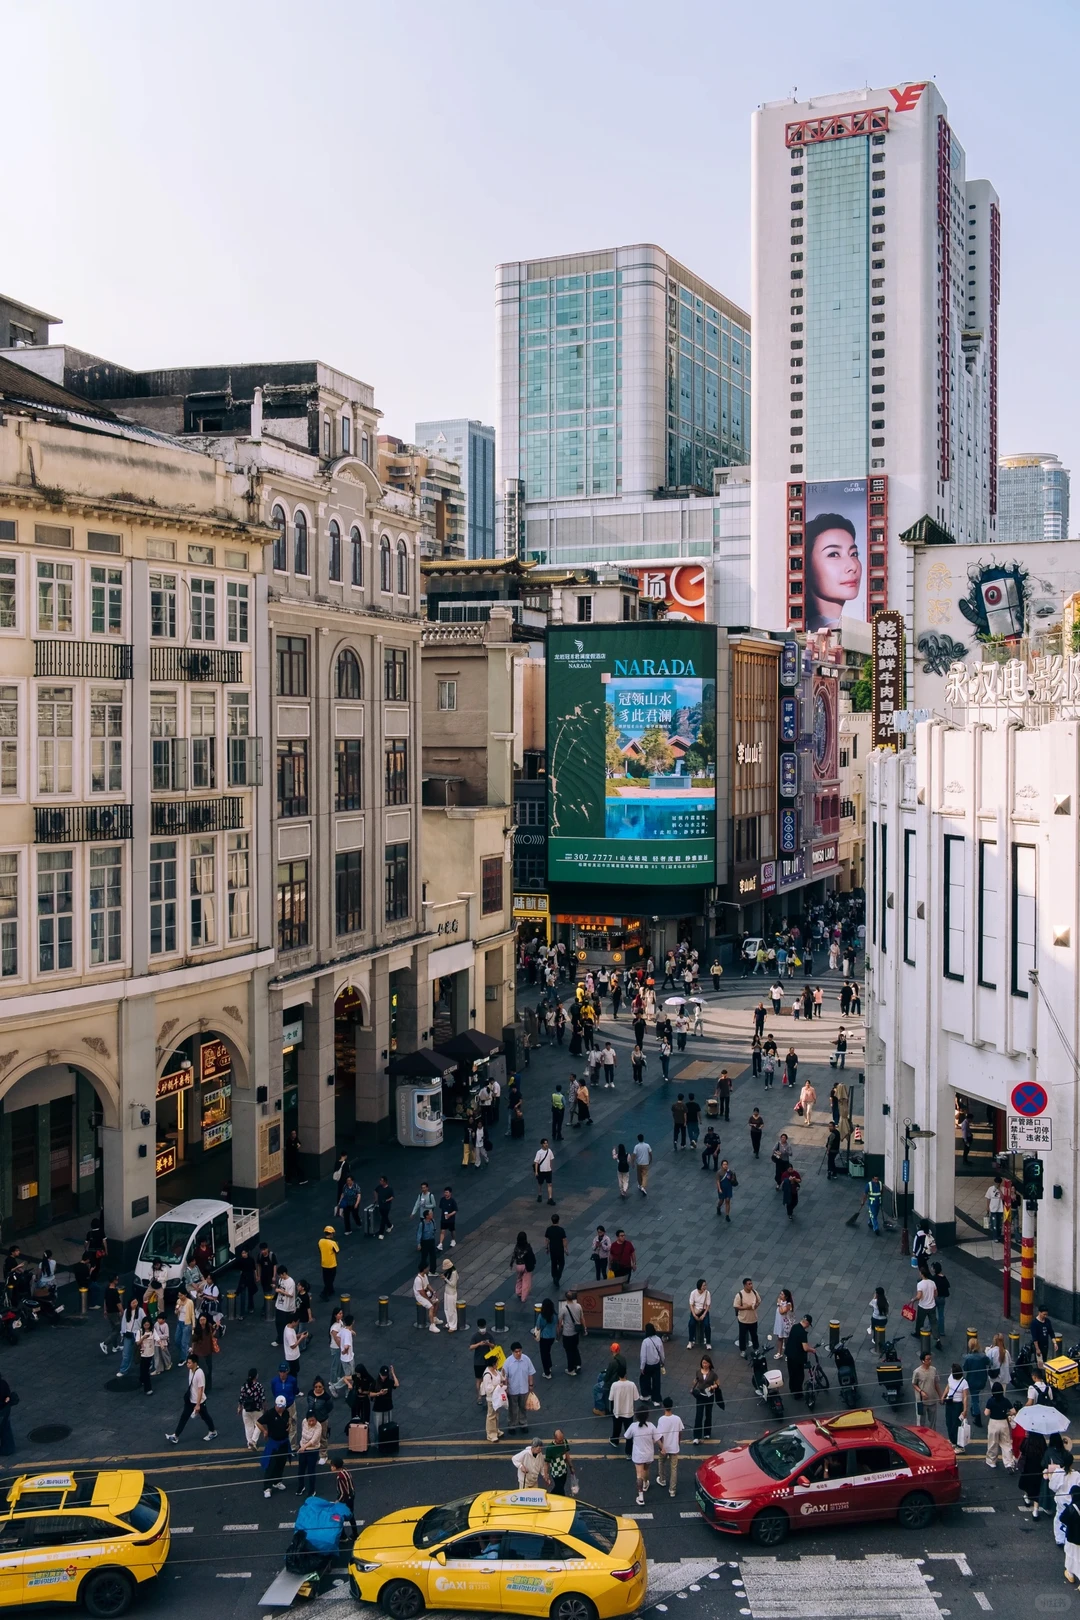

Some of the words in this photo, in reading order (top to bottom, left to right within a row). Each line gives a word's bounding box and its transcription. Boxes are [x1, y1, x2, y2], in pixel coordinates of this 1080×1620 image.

[614, 659, 697, 676] NARADA
[618, 692, 672, 706] 冠领山水
[1010, 1125, 1050, 1135] 禁止一切停
[1034, 1164, 1041, 1176] 3
[800, 1503, 829, 1516] TAXI
[435, 1576, 467, 1591] TAXI
